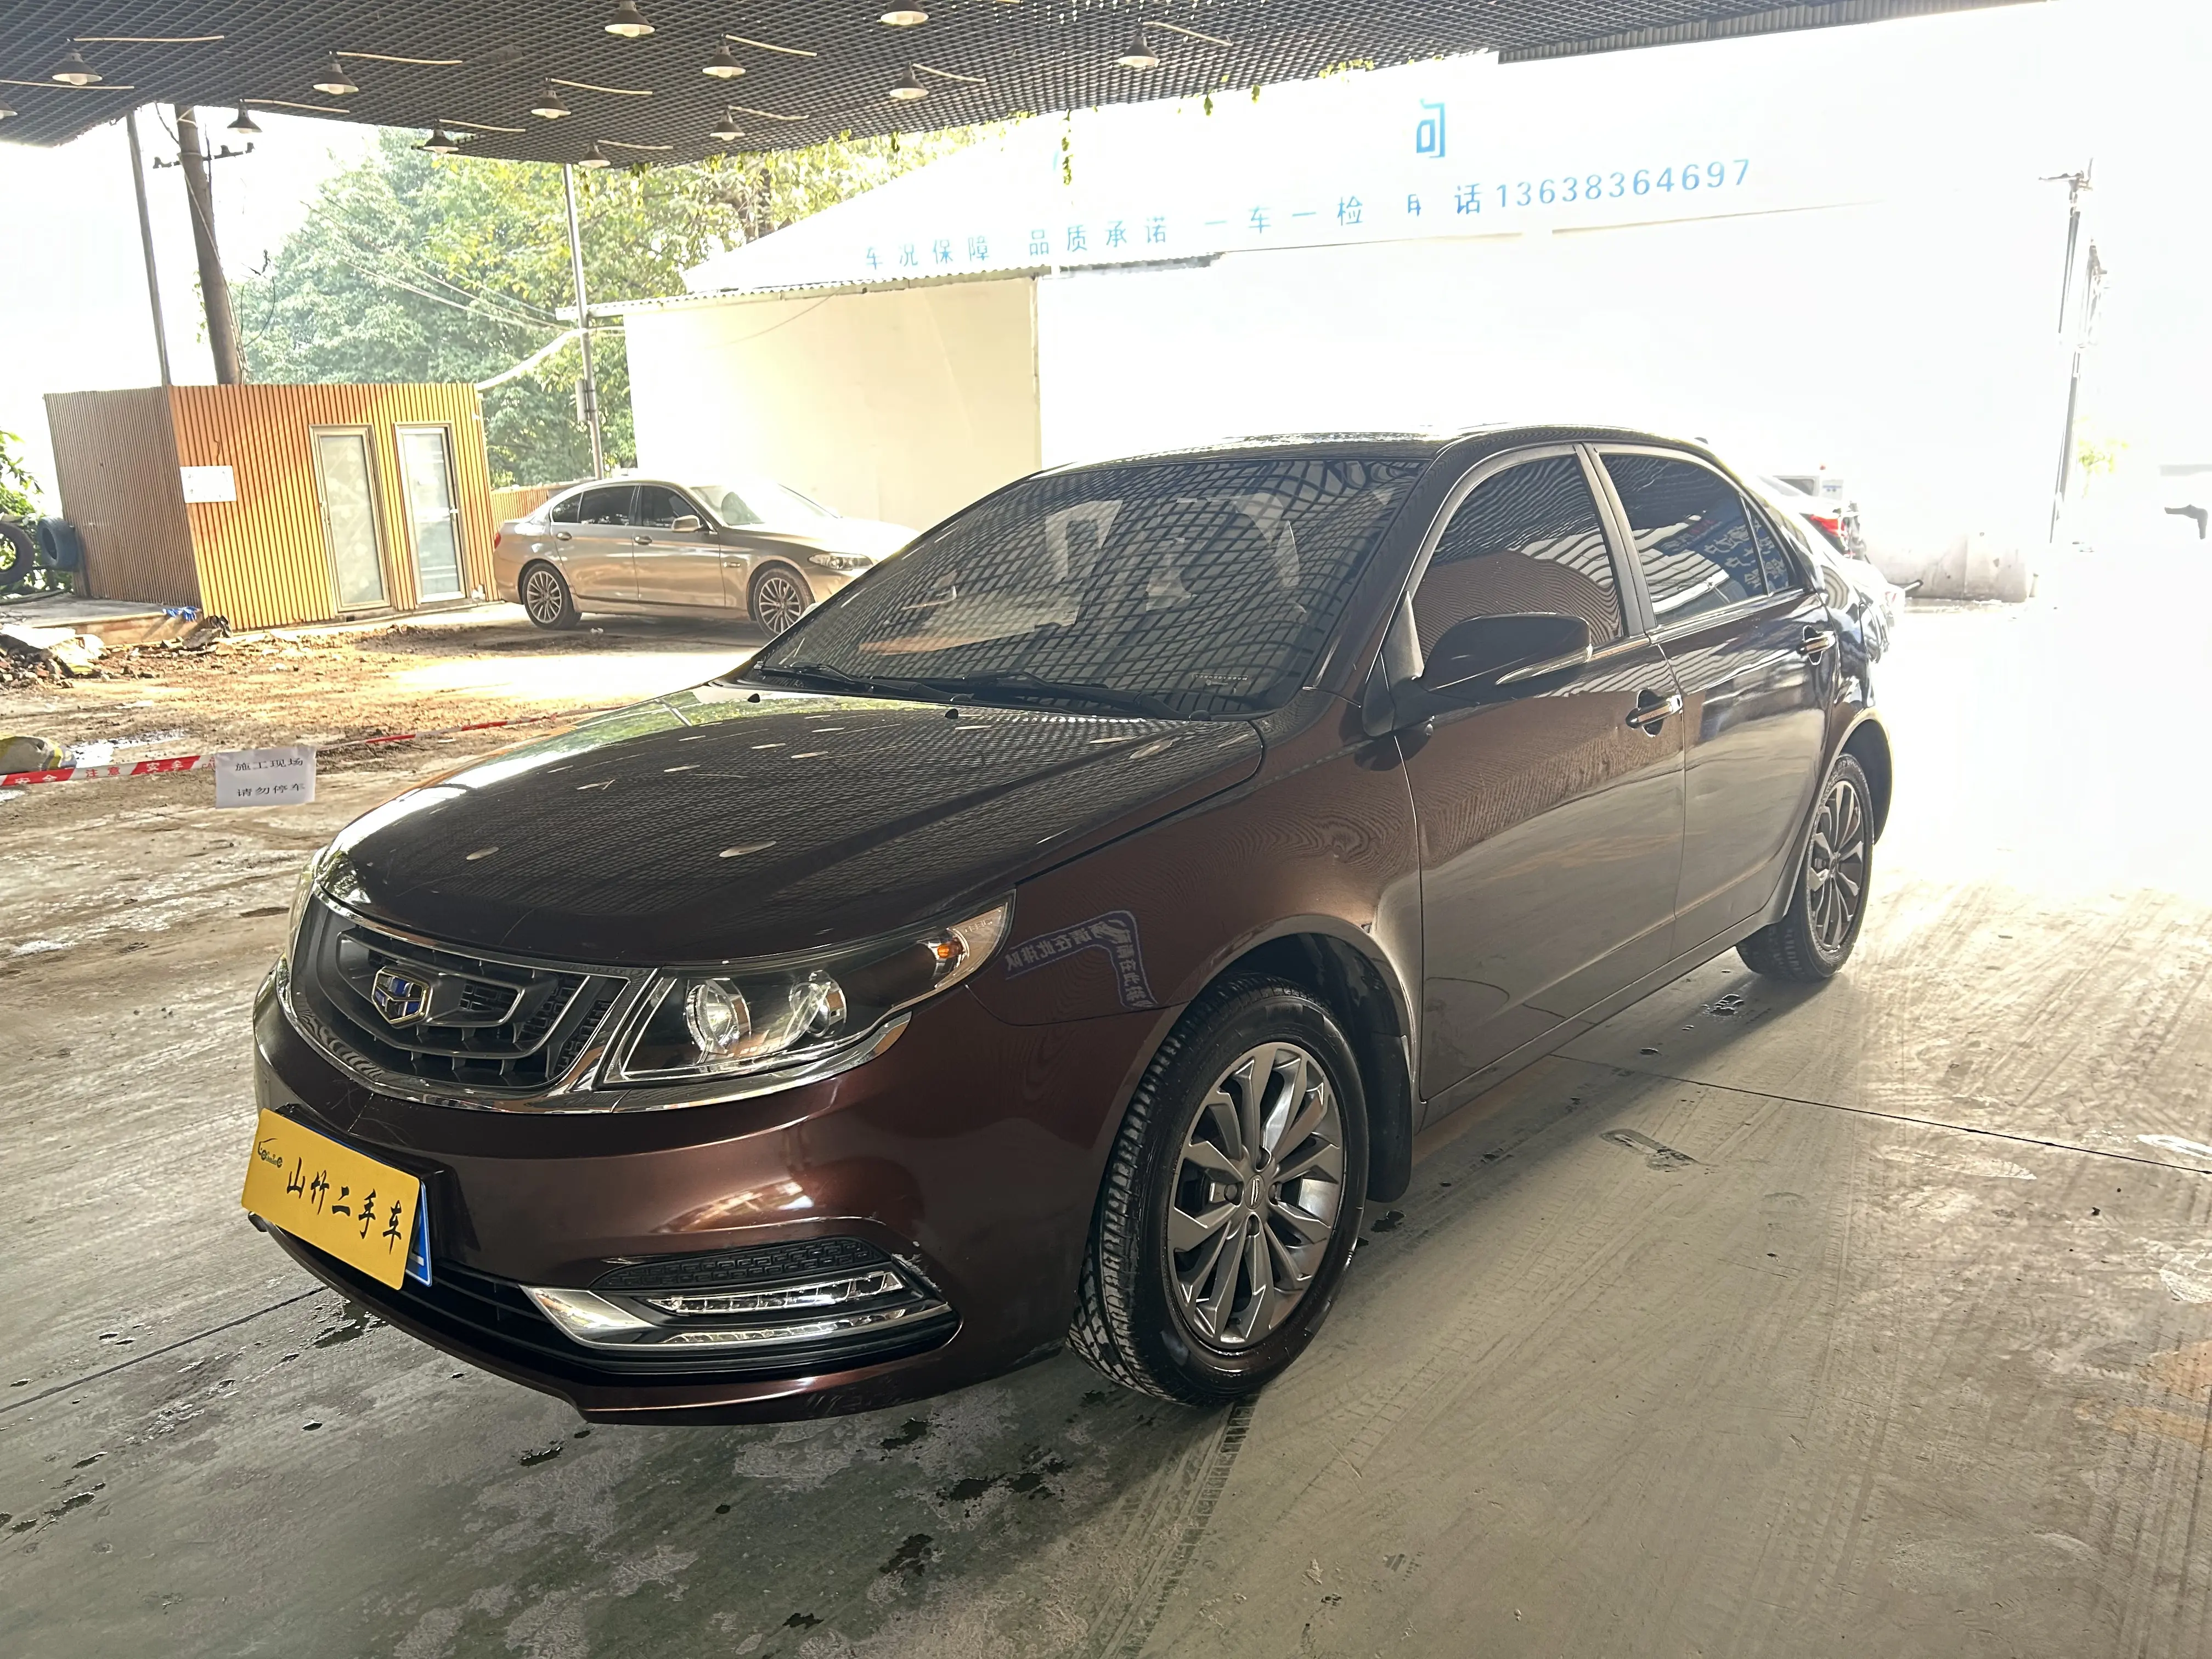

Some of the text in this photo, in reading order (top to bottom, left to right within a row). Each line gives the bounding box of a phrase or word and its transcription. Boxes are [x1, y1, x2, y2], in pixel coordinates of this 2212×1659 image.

[1204, 195, 1363, 234] 一车一检
[866, 236, 990, 270] 车况保障
[1029, 217, 1167, 256] 品质承诺
[235, 758, 303, 771] 施工现场
[238, 783, 306, 797] 请勿停车
[287, 1156, 402, 1255] 山竹二手车
